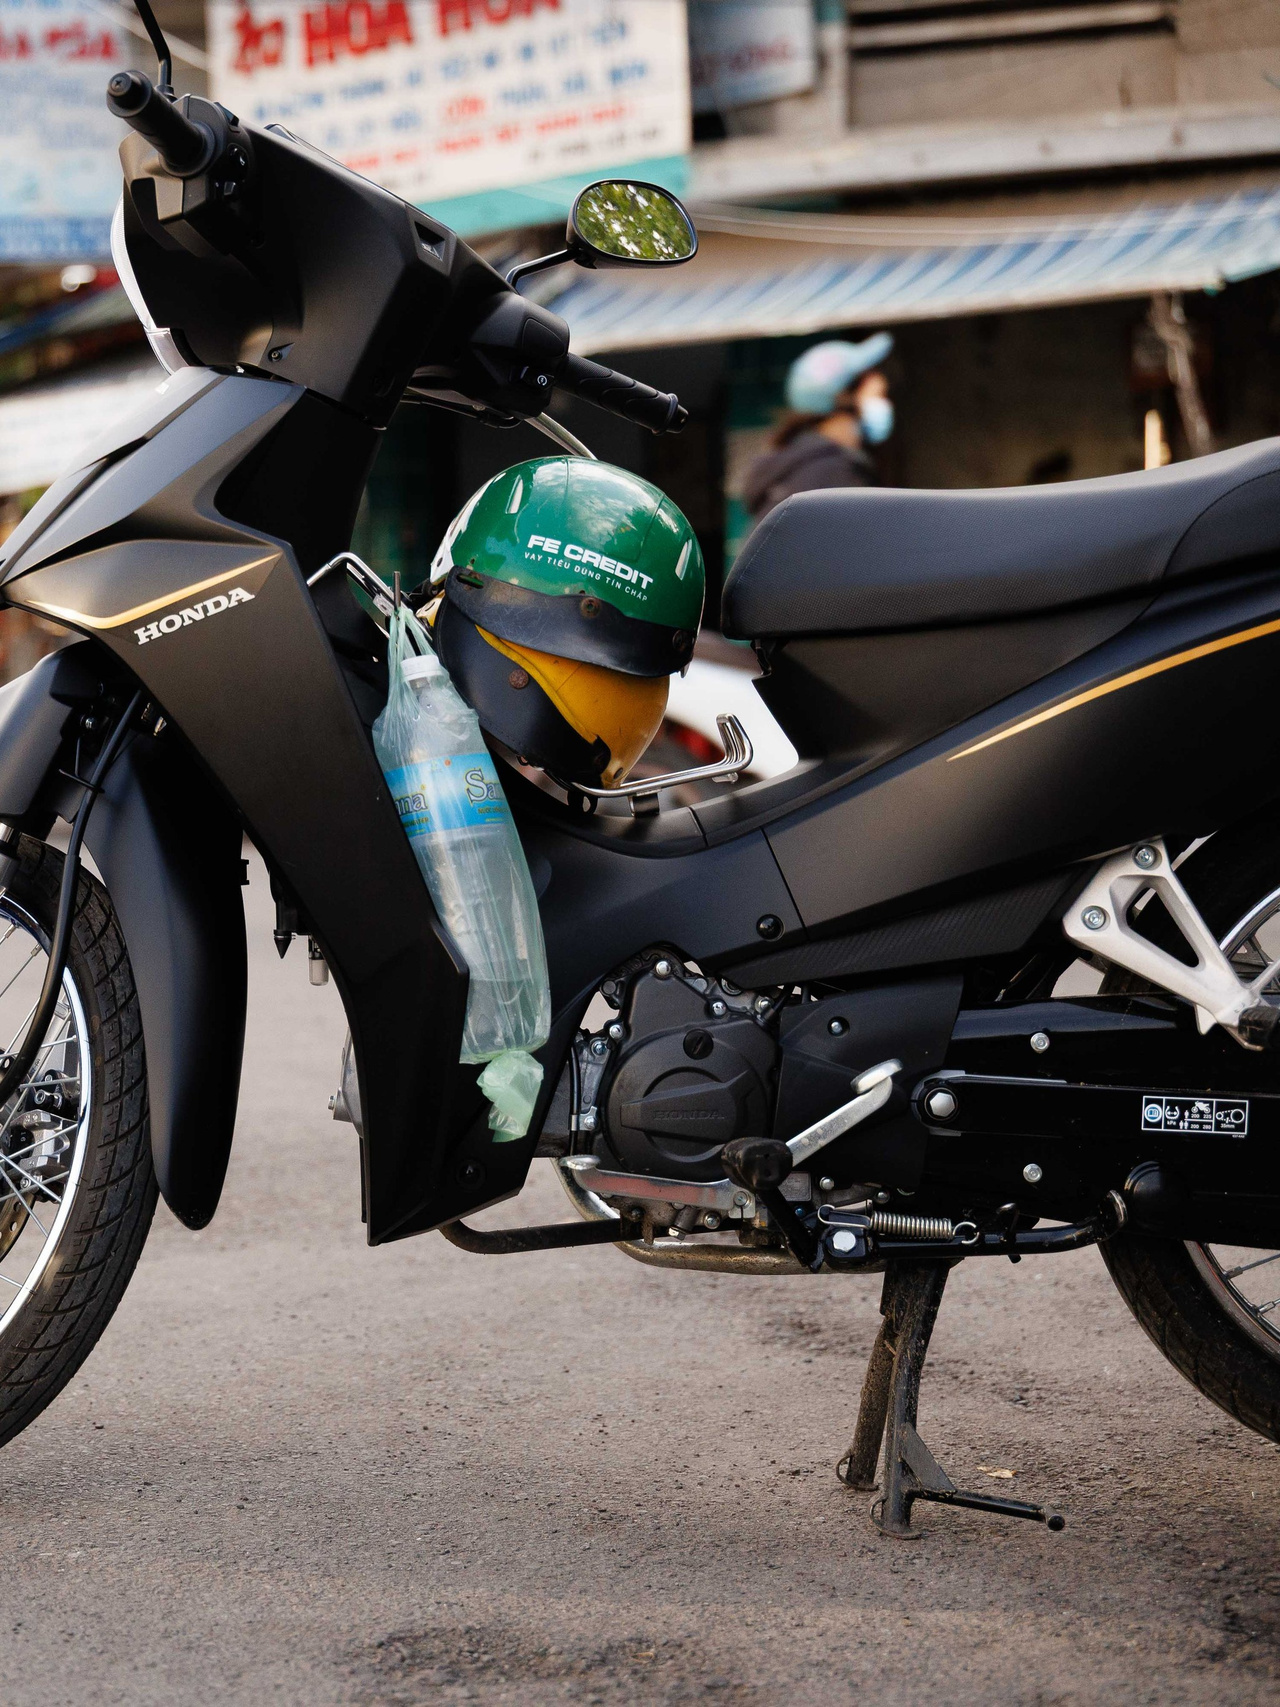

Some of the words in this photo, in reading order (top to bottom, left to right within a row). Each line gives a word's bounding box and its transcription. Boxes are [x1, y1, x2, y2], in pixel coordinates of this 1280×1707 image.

[524, 551, 543, 562] VAY
[547, 556, 571, 569] TIÊU
[527, 534, 562, 554] FE
[563, 543, 654, 589] CREDIT
[133, 587, 256, 645] HONDA
[653, 1109, 726, 1120] HONDA
